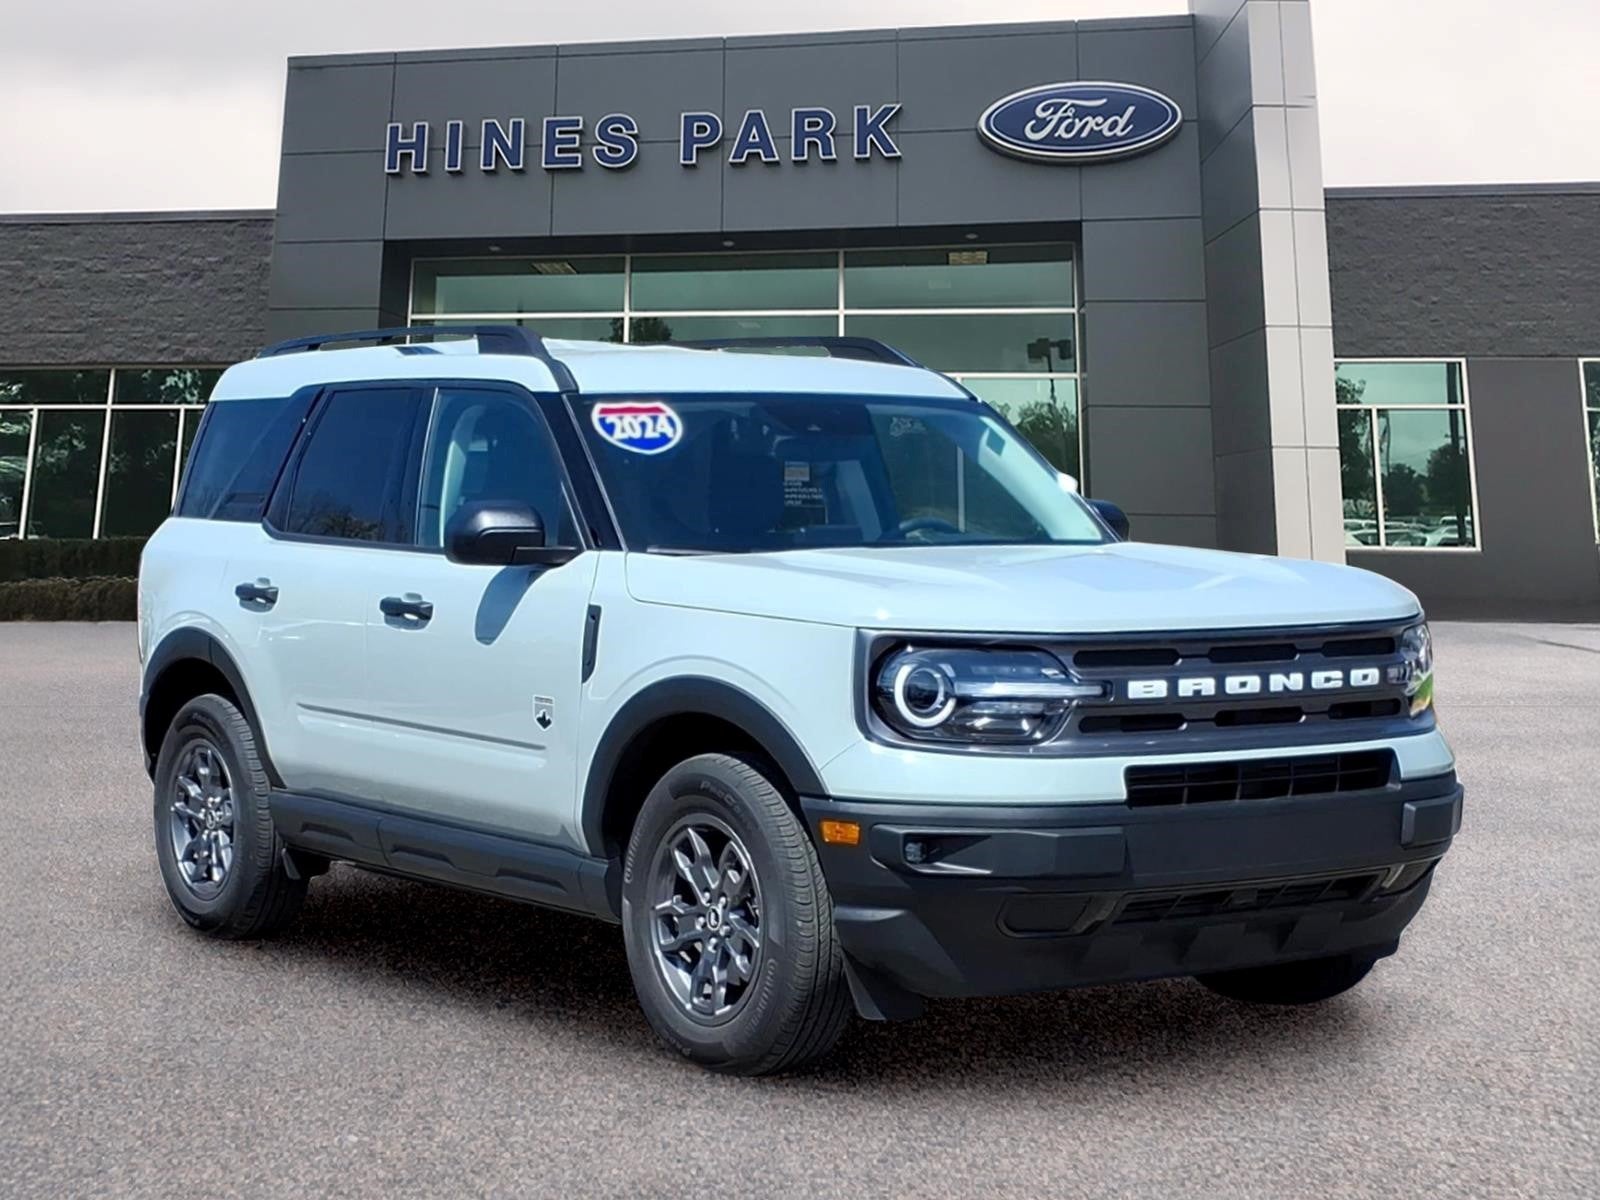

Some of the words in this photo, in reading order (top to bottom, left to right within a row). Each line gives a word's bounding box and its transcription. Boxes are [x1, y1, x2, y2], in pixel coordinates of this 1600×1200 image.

[384, 113, 639, 174] HINES
[680, 103, 903, 166] PARK
[1024, 98, 1136, 141] Ford
[605, 415, 675, 440] 2024
[1127, 667, 1380, 700] BRONCO
